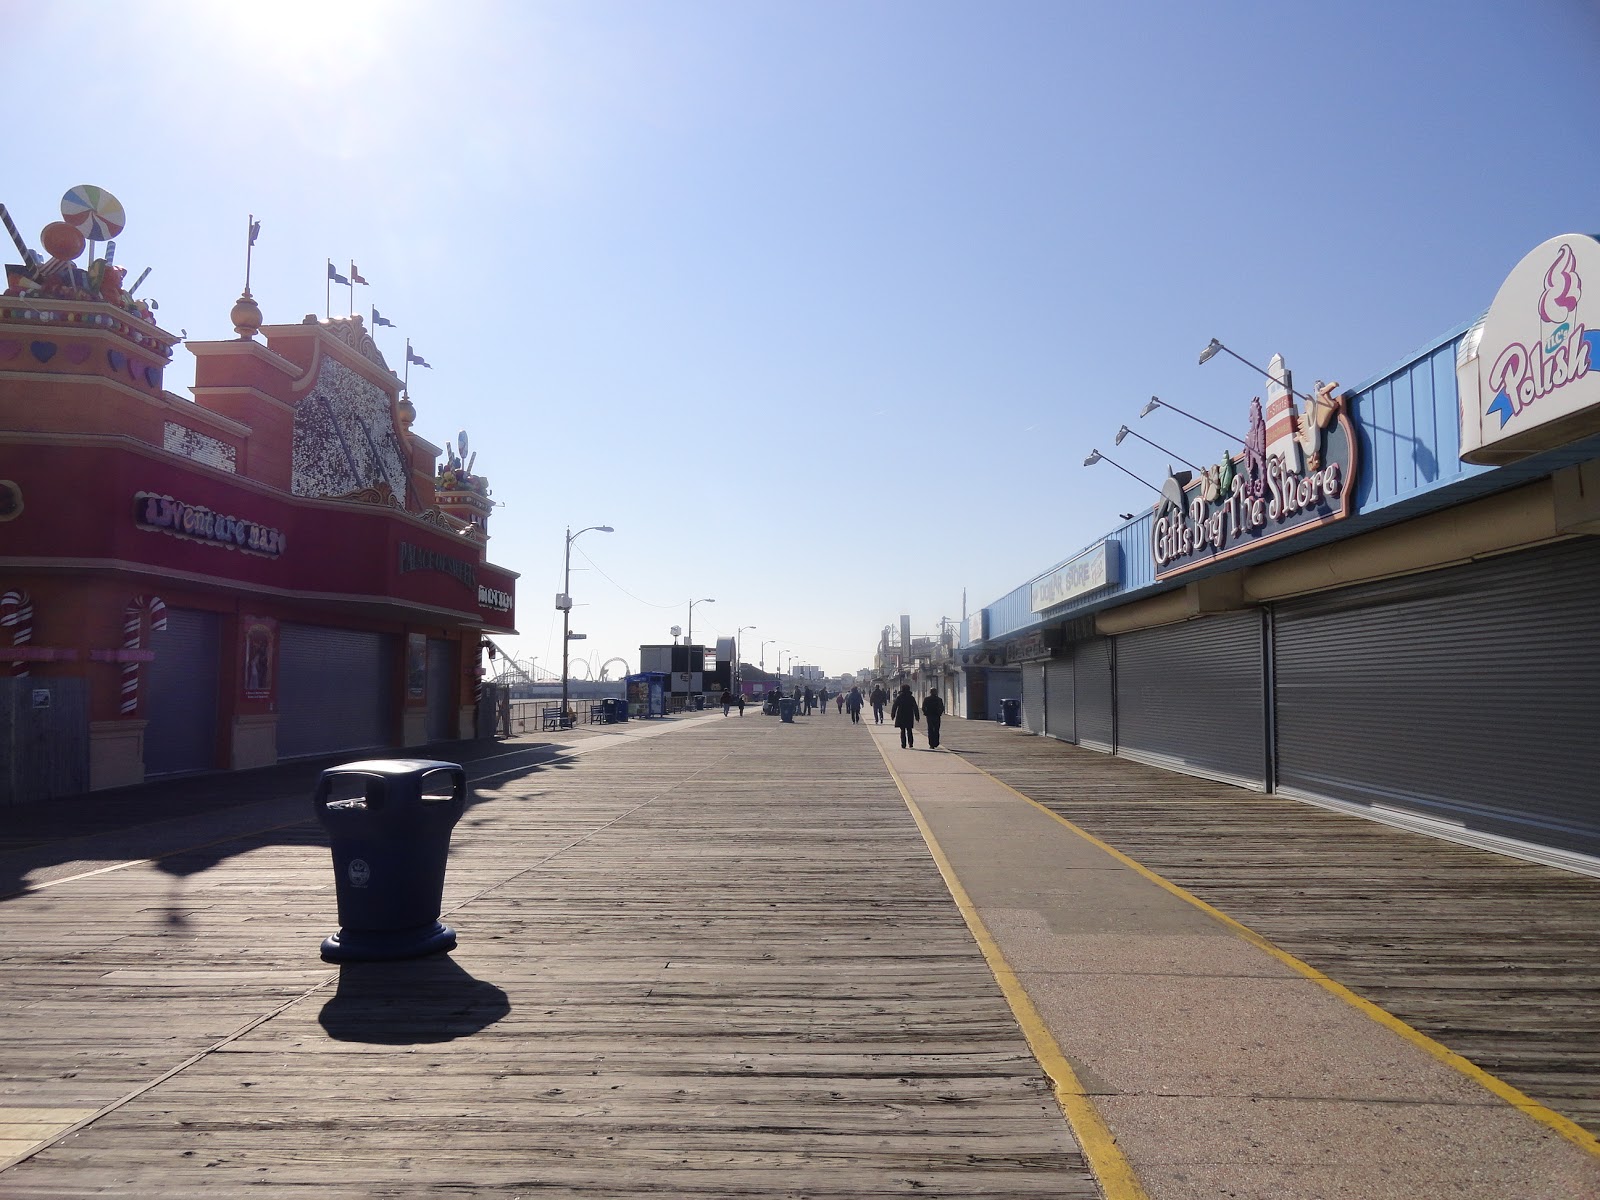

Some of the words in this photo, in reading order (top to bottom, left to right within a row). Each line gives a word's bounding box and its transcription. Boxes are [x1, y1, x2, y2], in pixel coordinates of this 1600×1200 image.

[1489, 323, 1592, 417] Polish
[1154, 507, 1192, 564] Gifts
[1189, 497, 1223, 549] Buy
[1224, 474, 1264, 537] The
[1267, 456, 1340, 520] Shore
